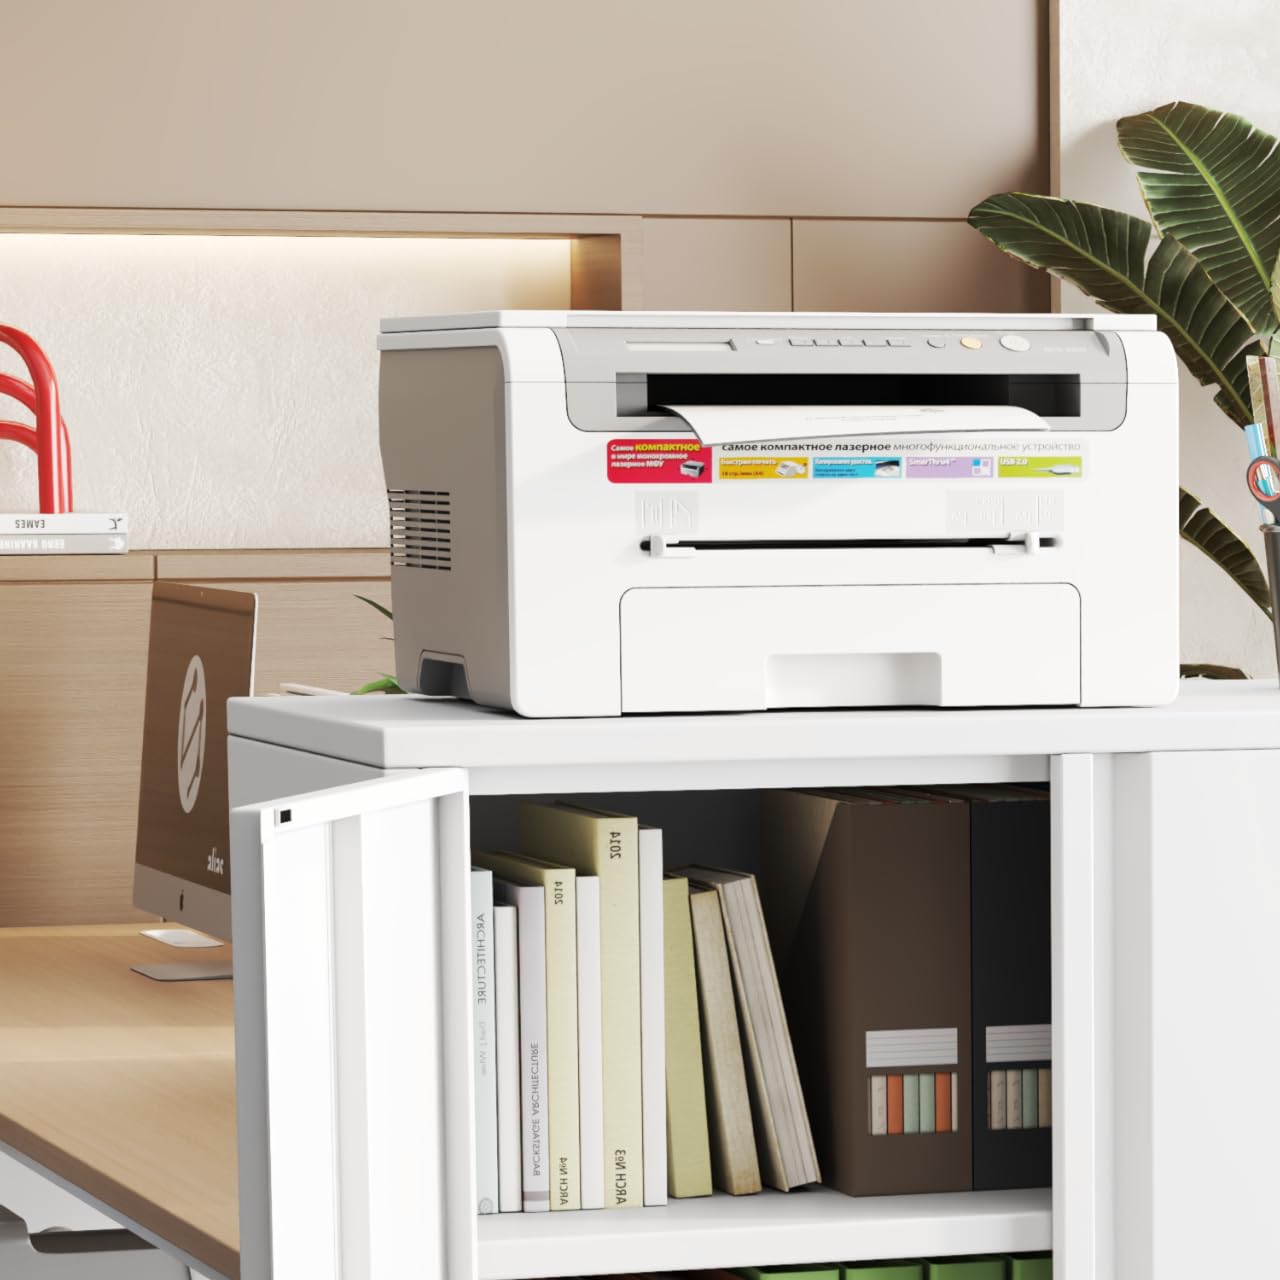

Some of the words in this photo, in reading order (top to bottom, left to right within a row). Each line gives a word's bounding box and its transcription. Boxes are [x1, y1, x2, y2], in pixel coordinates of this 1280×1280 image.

[634, 443, 701, 452] компактное
[760, 443, 832, 452] компактное
[834, 442, 891, 453] лазерное
[893, 440, 1021, 453] многофункциональное
[15, 519, 45, 529] EAMES
